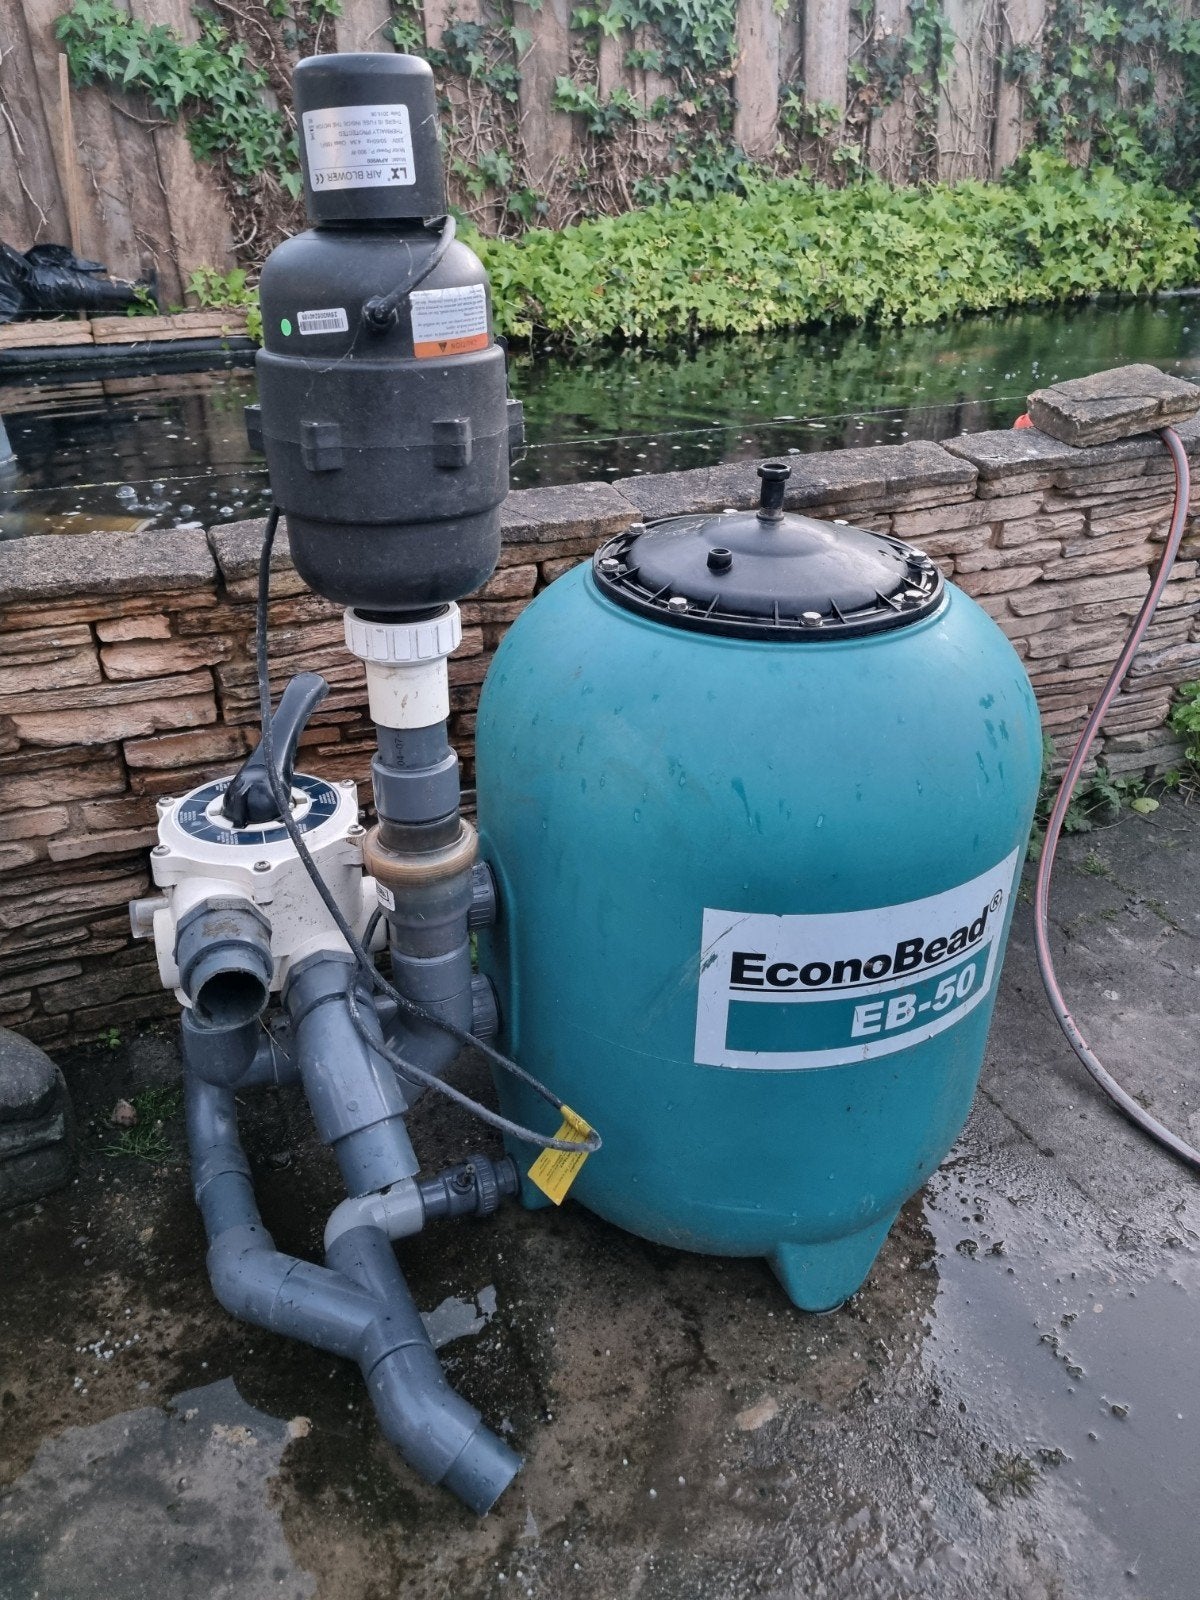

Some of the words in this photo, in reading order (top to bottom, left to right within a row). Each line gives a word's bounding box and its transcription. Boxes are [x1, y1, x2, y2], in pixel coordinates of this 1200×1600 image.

[327, 170, 364, 182] BLOWER
[366, 169, 382, 179] AIR
[851, 962, 977, 1038] EB-50
